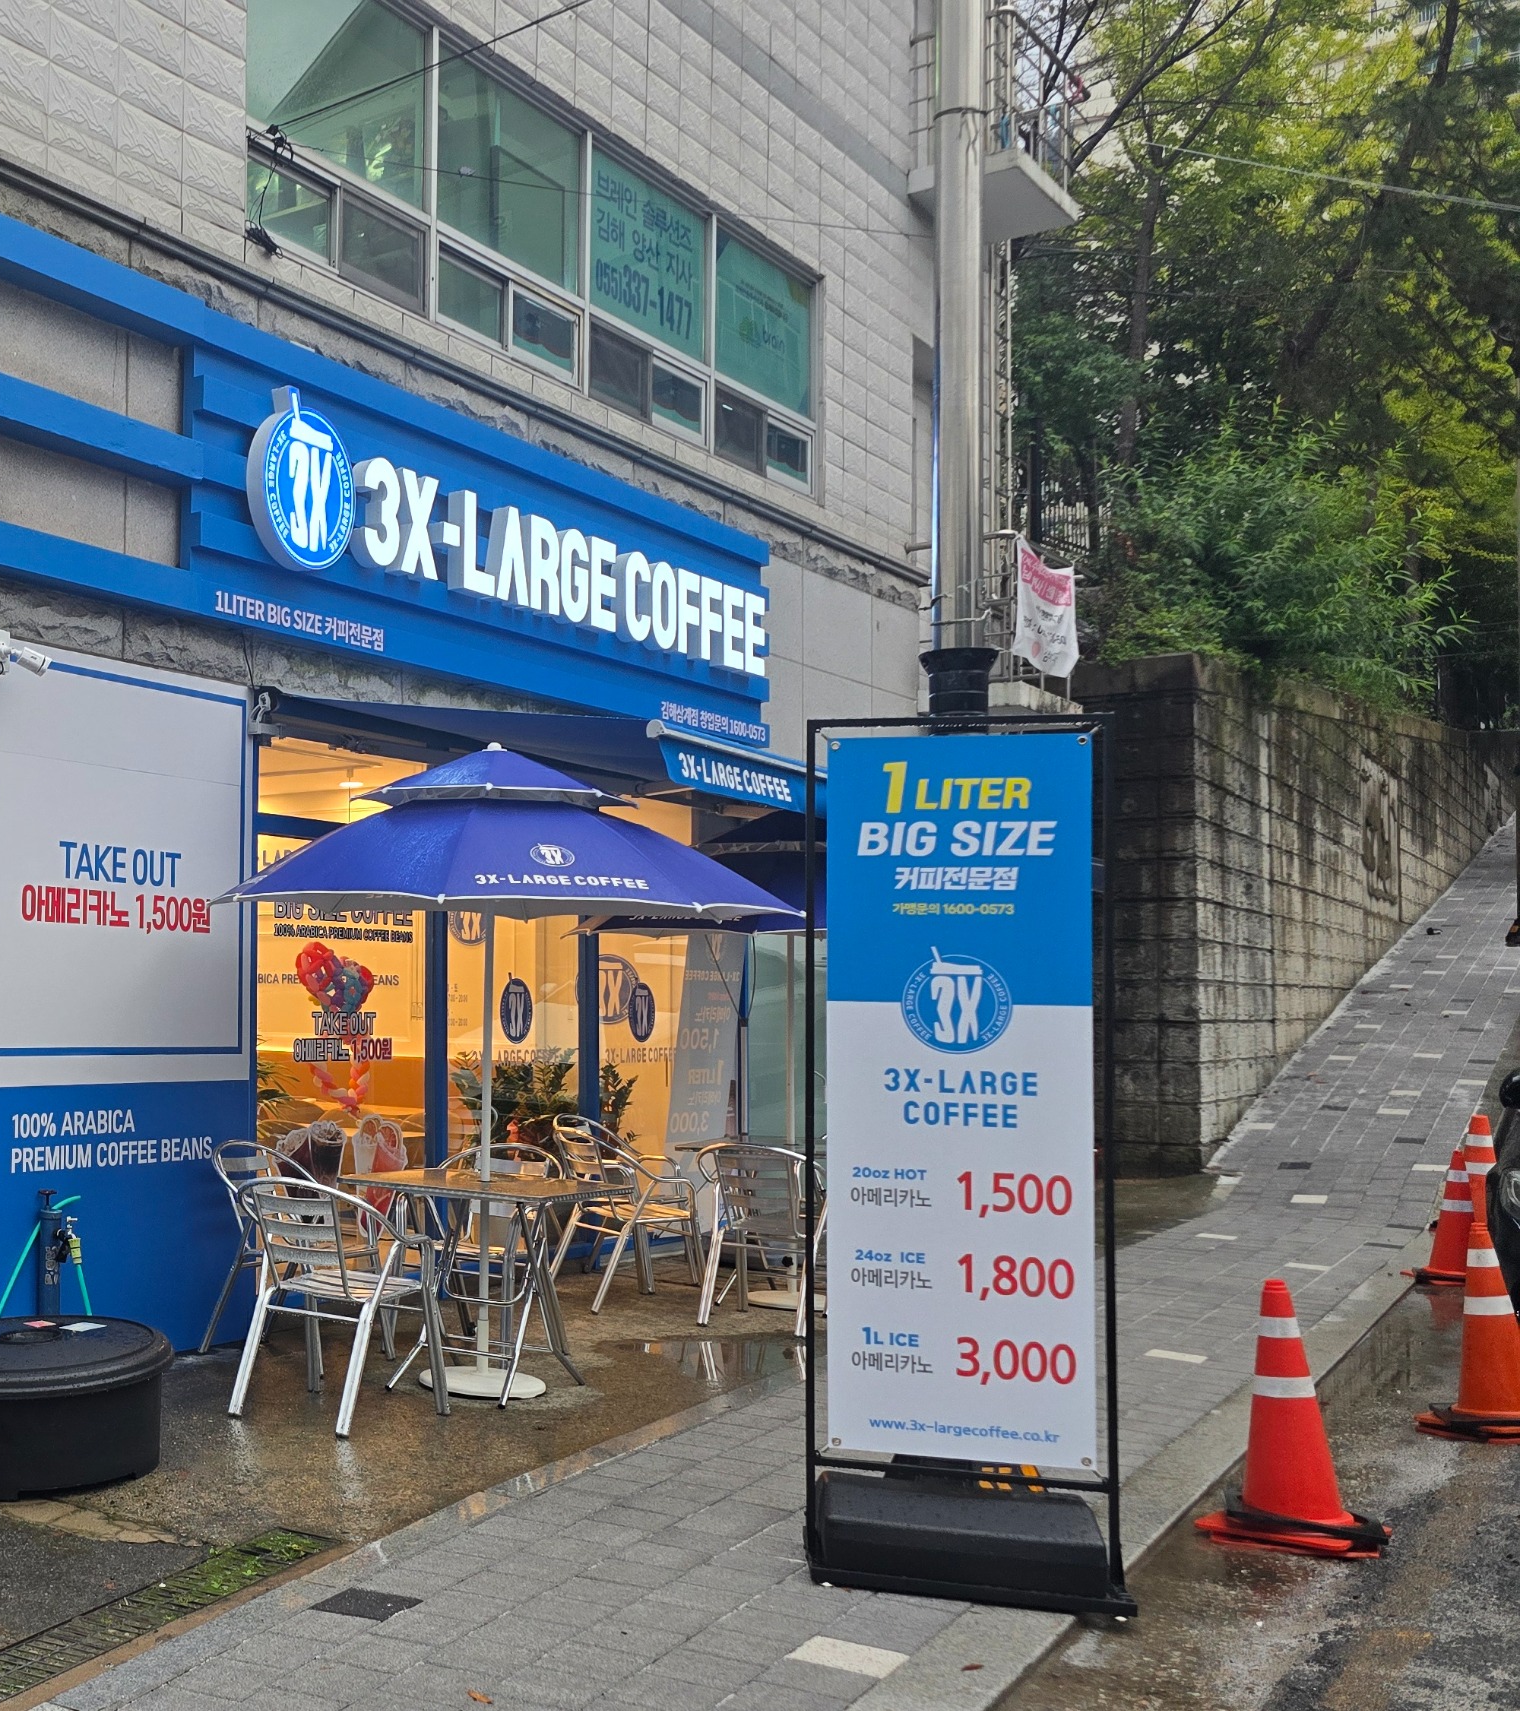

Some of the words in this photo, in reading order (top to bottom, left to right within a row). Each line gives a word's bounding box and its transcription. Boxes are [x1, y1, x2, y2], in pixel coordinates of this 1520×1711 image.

[596, 170, 637, 221] 브레인
[642, 200, 693, 253] 솔루션즈
[596, 208, 625, 251] 김해
[632, 230, 660, 271] 양산
[666, 251, 693, 291] 지사
[596, 259, 693, 340] 055)337-1477
[289, 440, 332, 552] 3X
[356, 457, 617, 633] 3X-LARGE
[618, 551, 767, 678] COFFEE
[215, 591, 265, 622] 1LITER
[267, 603, 291, 628] BIG
[293, 609, 323, 635] SIZE
[324, 617, 384, 652] 커피전문점
[661, 701, 698, 726] 김해삼계점
[700, 710, 728, 734] 창업문의
[730, 719, 766, 742] 1600-0573
[678, 752, 743, 791] 3X-LARGE
[742, 770, 792, 802] COFFEE
[882, 761, 908, 813] 1
[915, 777, 1032, 810] LITER
[857, 821, 937, 857] BIG
[950, 820, 1058, 857] SIZE
[59, 841, 126, 885] TAKE
[132, 848, 182, 888] OUT
[894, 866, 1019, 892] 커피전문점
[474, 874, 571, 886] 3X-LARGE
[574, 875, 649, 890] COFFEE
[21, 884, 129, 928] 아메리카노
[134, 893, 211, 935] 1,500원
[892, 902, 941, 916] 가맹문의
[942, 902, 1015, 916] 1600-0573
[273, 923, 295, 937] 100%
[295, 925, 328, 939] ARABICA
[329, 927, 362, 941] PREMIUM
[363, 929, 389, 942] COFFEE
[390, 930, 413, 943] BEANS
[373, 975, 399, 986] EANS
[312, 1012, 348, 1036] TAKE
[348, 1012, 376, 1035] OUT
[930, 975, 983, 1045] 3X
[292, 1038, 350, 1062] 아메리카노
[350, 1037, 392, 1061] 1,500원
[605, 1048, 647, 1063] 3X-LARGE
[884, 1068, 1038, 1097] 3X-LARGE
[12, 1111, 57, 1139] 100%
[60, 1109, 135, 1136] ARABICA
[903, 1100, 1018, 1129] COFFEE
[11, 1143, 92, 1173] PREMIUM
[96, 1140, 157, 1167] COFFEE
[160, 1135, 212, 1162] BEANS
[852, 1166, 890, 1180] 20oz
[893, 1168, 927, 1182] HOT
[851, 1187, 932, 1208] 아메리카노
[957, 1171, 1073, 1218] 1,500
[855, 1249, 892, 1263] 24oz
[900, 1252, 926, 1265] ICE
[851, 1268, 933, 1290] 아메리카노
[957, 1253, 1075, 1301] 1,800
[861, 1327, 884, 1346] 1L
[888, 1331, 919, 1348] ICE
[852, 1351, 933, 1375] 아메리카노
[956, 1336, 1077, 1385] 3,000
[869, 1417, 1061, 1444] www.3x-largecoffee.co.kr
